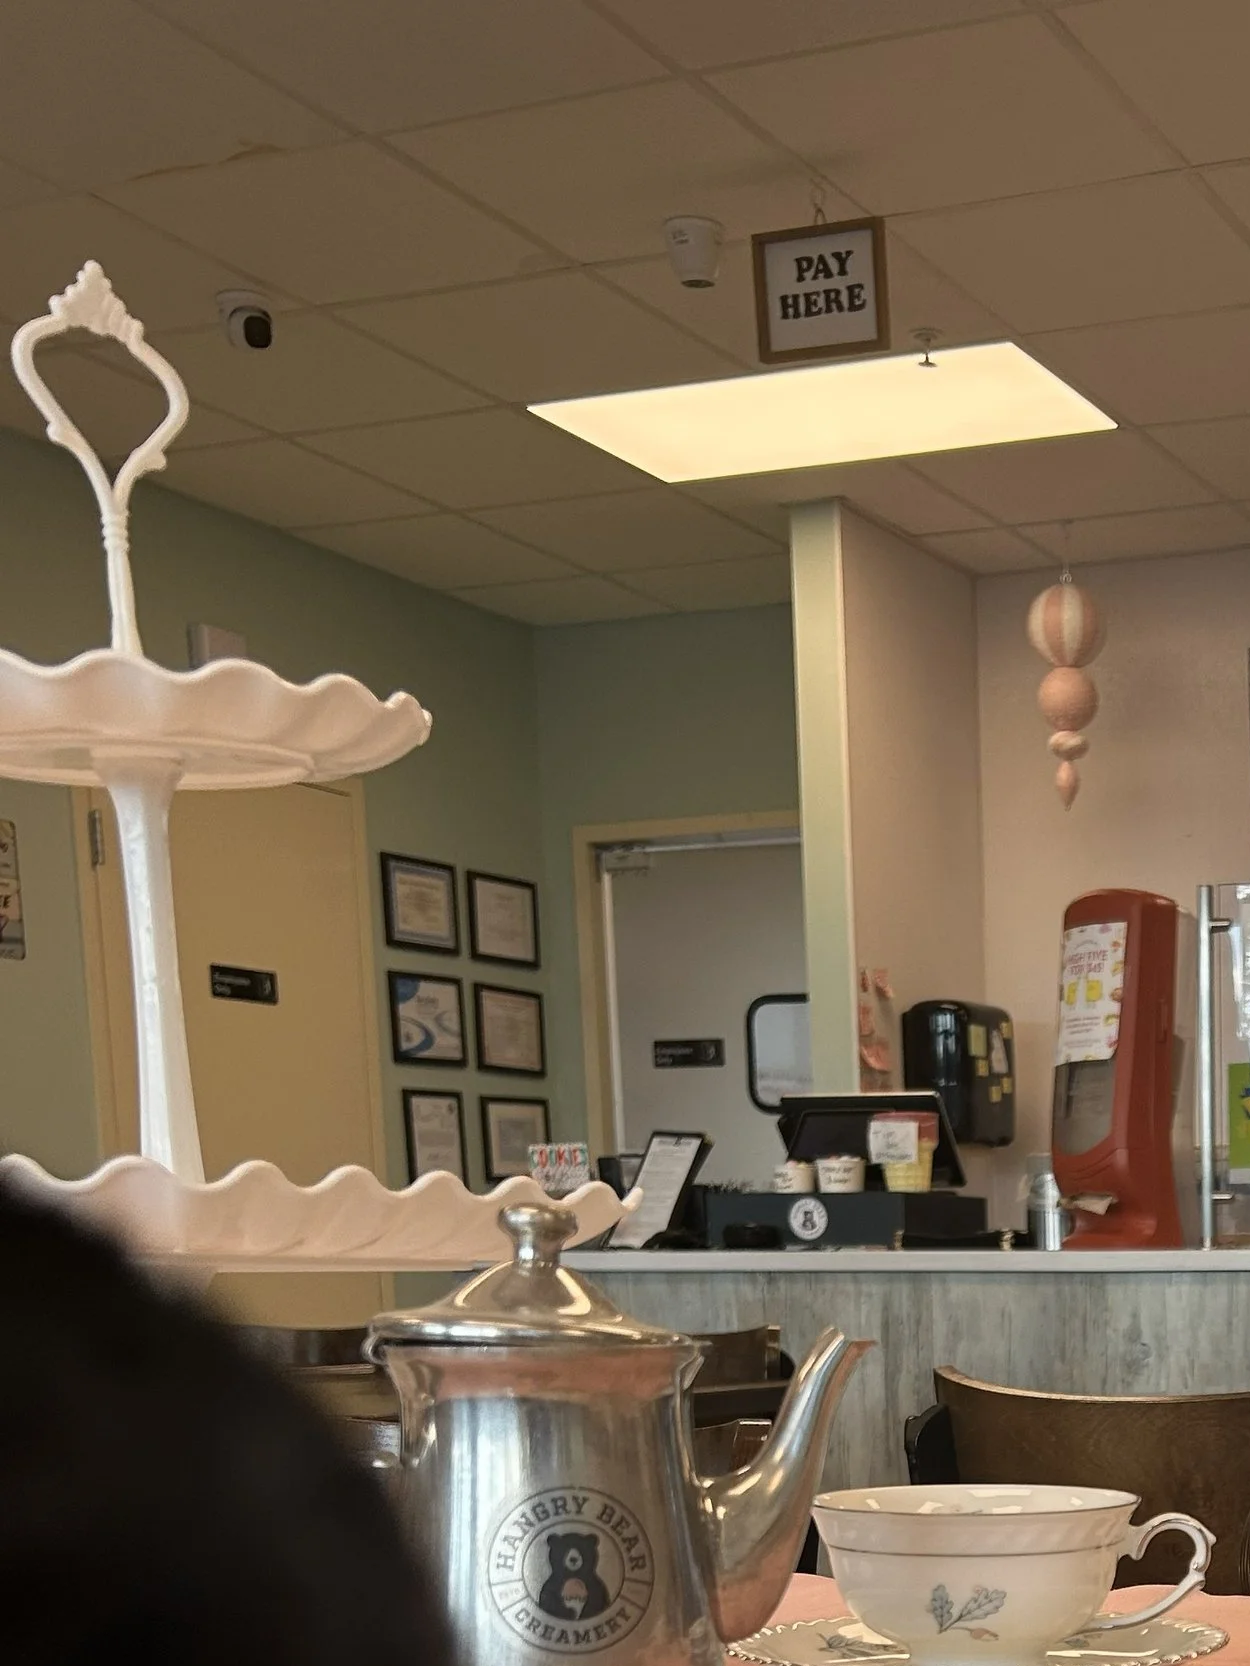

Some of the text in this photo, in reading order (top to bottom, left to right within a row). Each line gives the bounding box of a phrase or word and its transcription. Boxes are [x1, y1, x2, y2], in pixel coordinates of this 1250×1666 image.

[794, 250, 854, 283] PAY
[779, 283, 867, 320] HERE
[496, 1495, 647, 1572] HANGRY BEAR
[514, 1607, 631, 1645] CREAMERY
